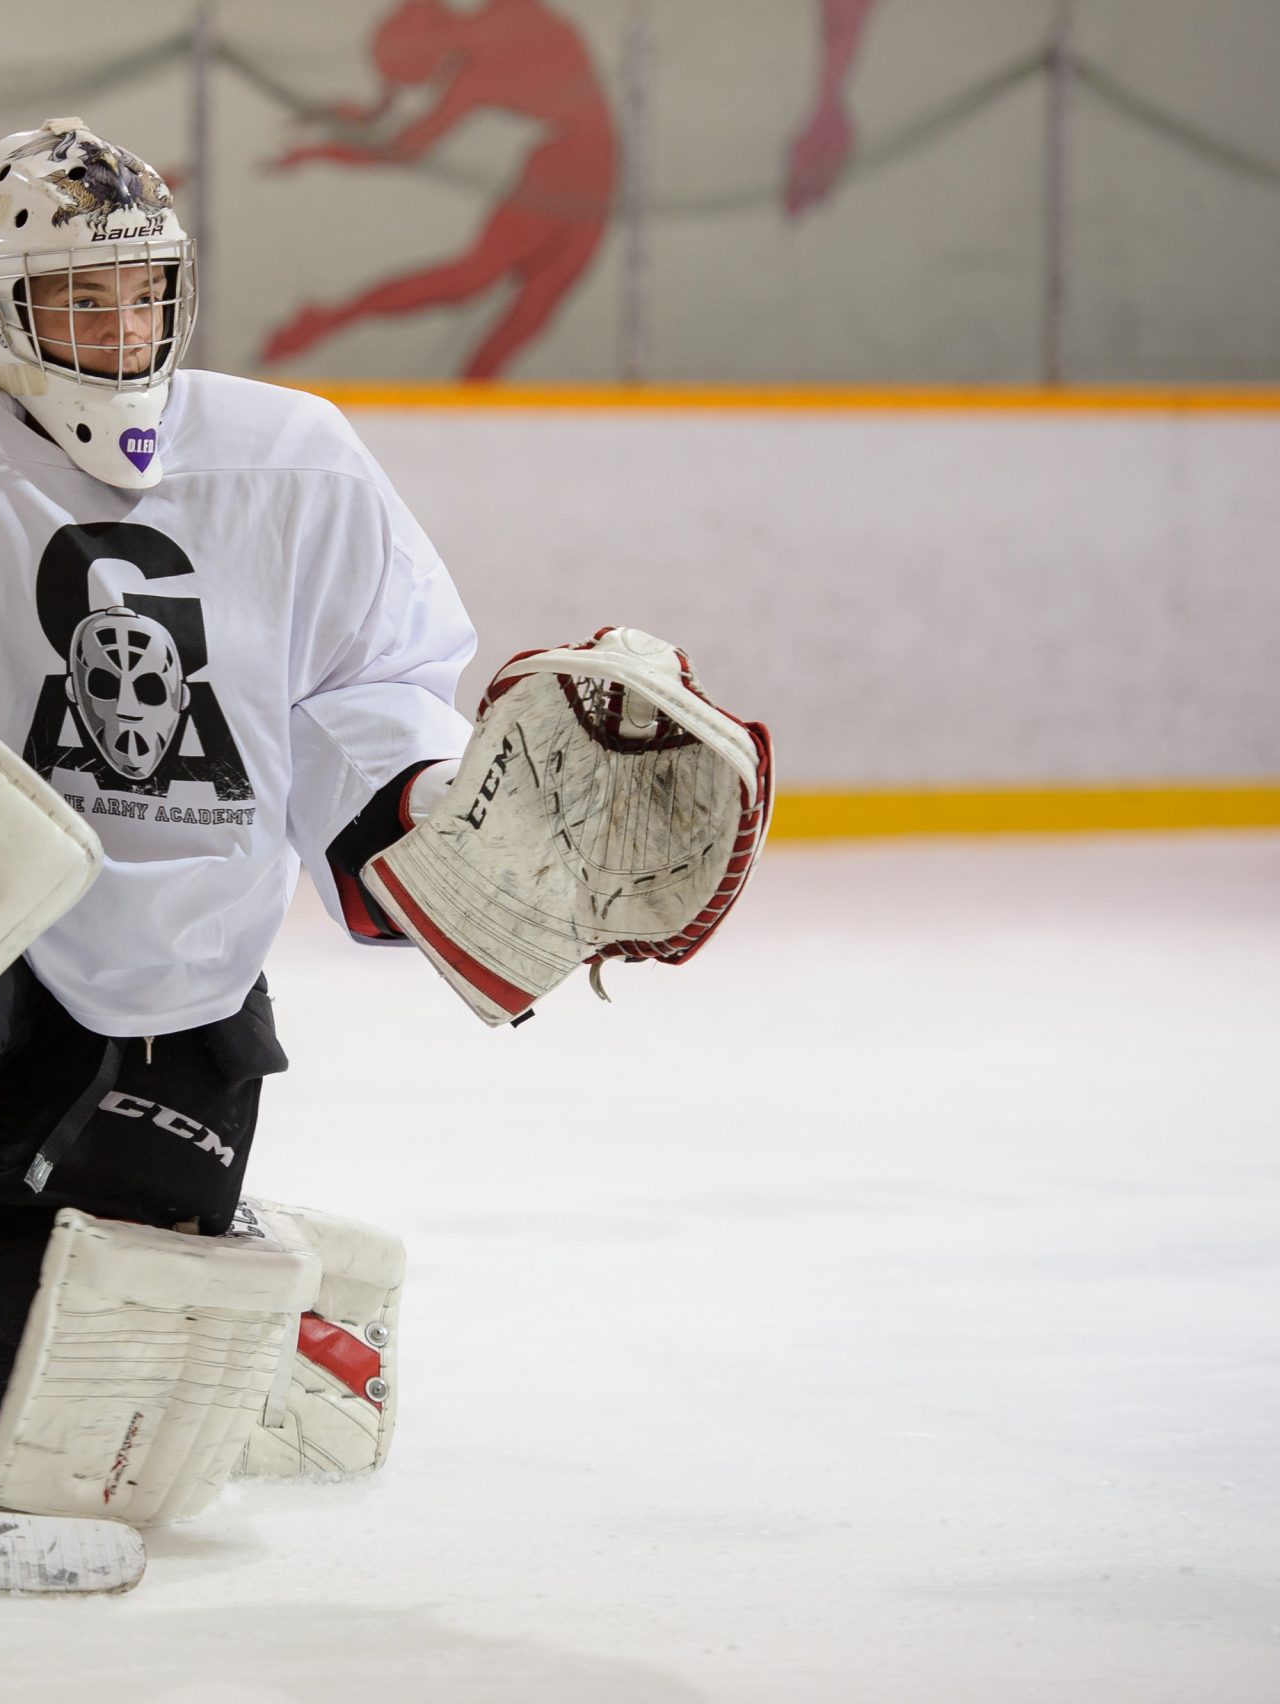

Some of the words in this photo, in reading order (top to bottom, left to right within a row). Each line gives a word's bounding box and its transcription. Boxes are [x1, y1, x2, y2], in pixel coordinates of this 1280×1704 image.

[92, 797, 149, 820] ARMY
[155, 805, 257, 825] ACADEMY
[466, 736, 513, 830] CCM
[98, 1090, 236, 1168] CCM
